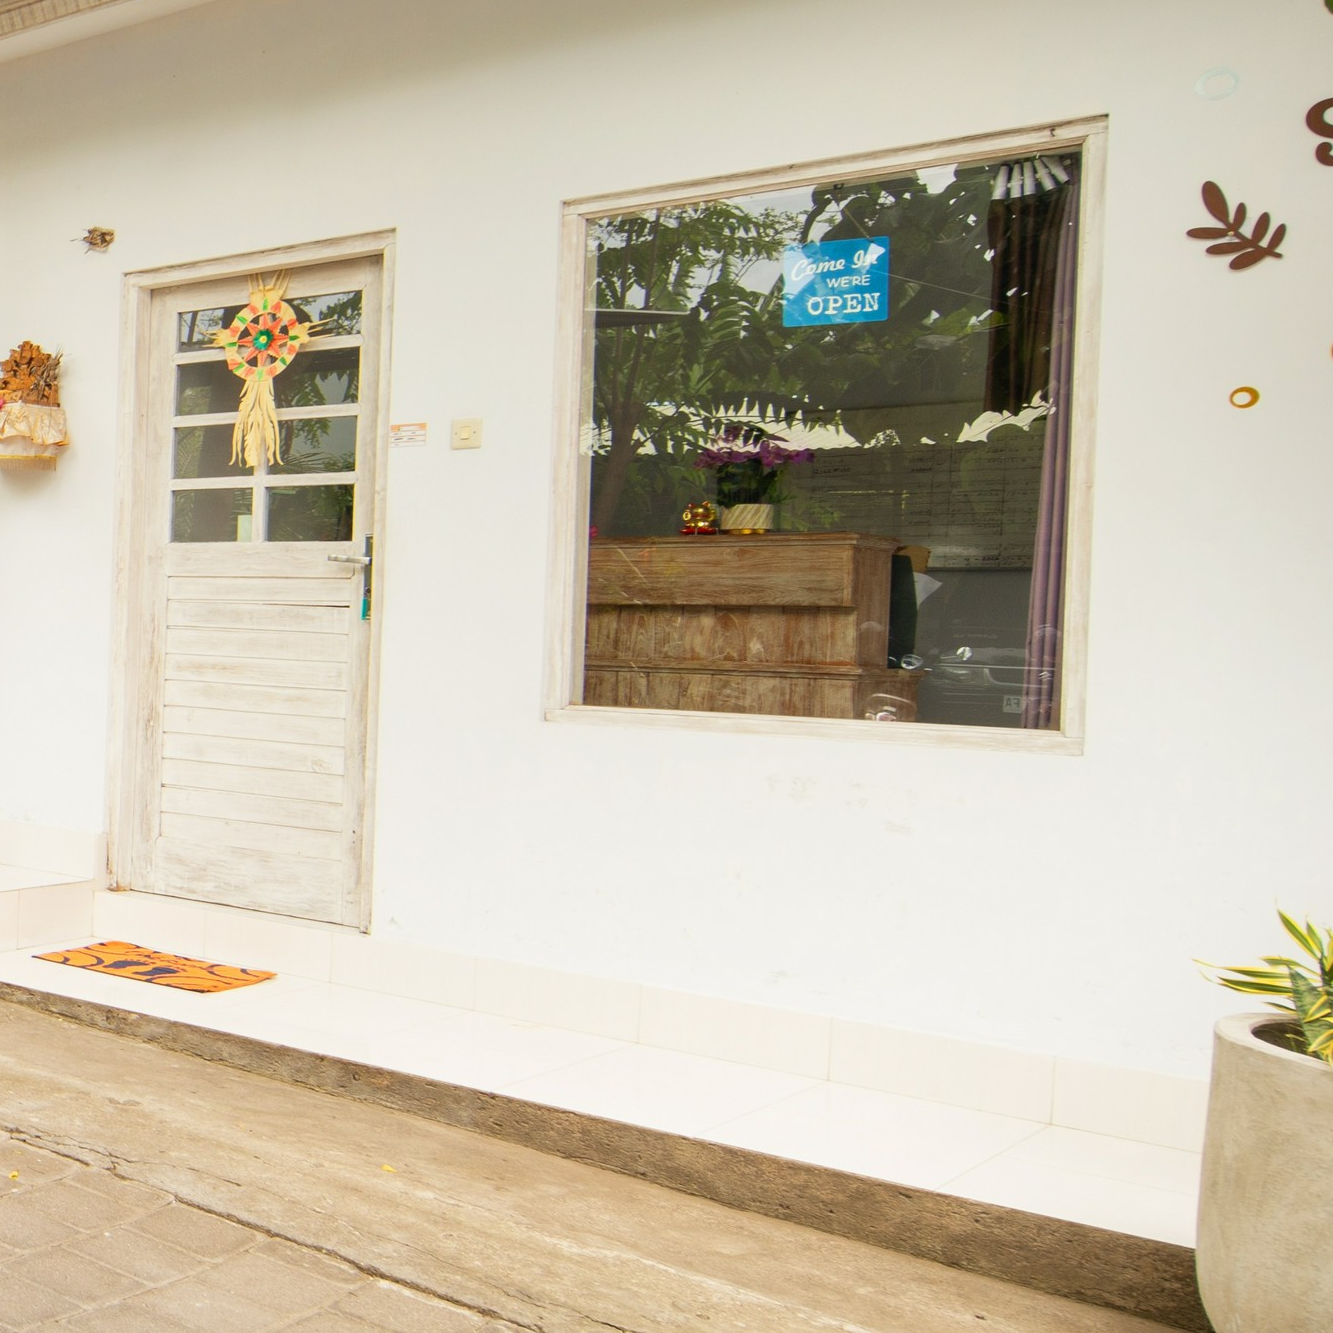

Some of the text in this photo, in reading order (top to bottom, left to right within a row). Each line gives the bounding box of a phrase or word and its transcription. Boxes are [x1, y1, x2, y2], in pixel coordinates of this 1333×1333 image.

[791, 250, 879, 281] Come In
[826, 274, 871, 289] WE'RE
[807, 292, 881, 316] OPEN
